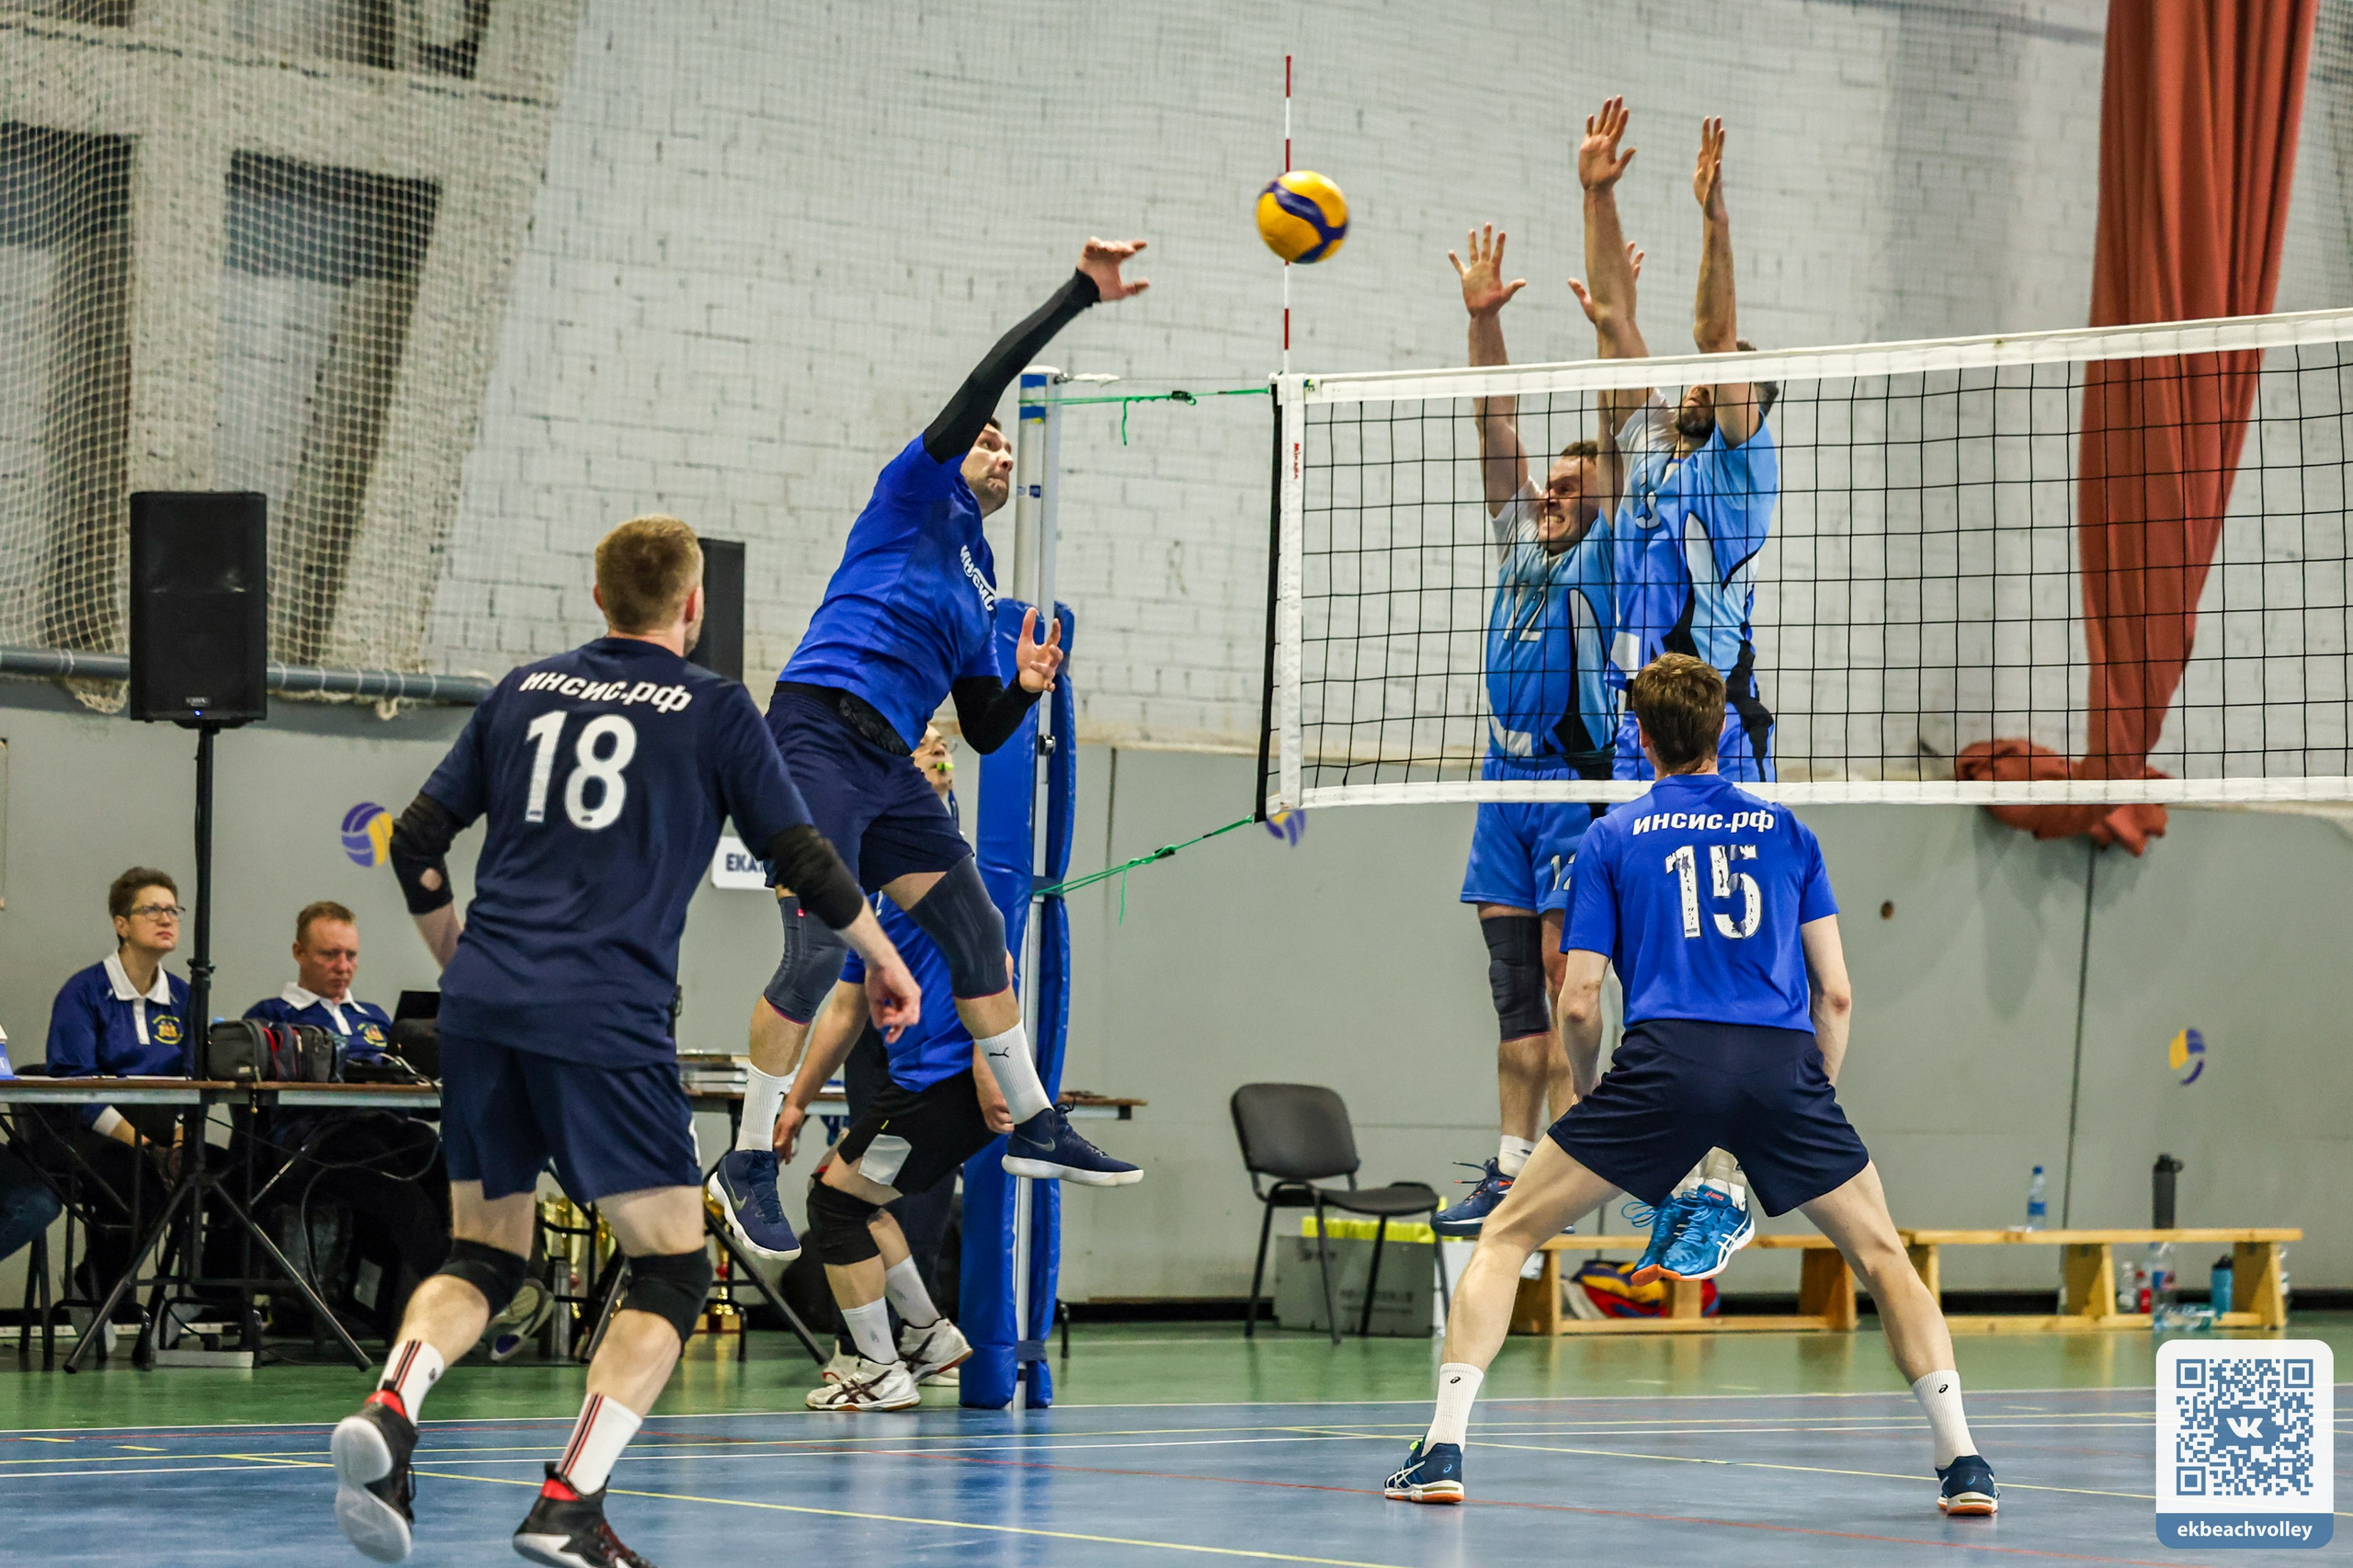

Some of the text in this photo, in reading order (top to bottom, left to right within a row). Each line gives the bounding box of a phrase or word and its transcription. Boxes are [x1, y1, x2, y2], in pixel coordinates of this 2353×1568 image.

[1503, 579, 1548, 642] 12
[519, 672, 692, 713] инсис.рф
[525, 710, 637, 830] 18
[1632, 810, 1775, 835] инсис.рф
[1665, 845, 1762, 939] 15
